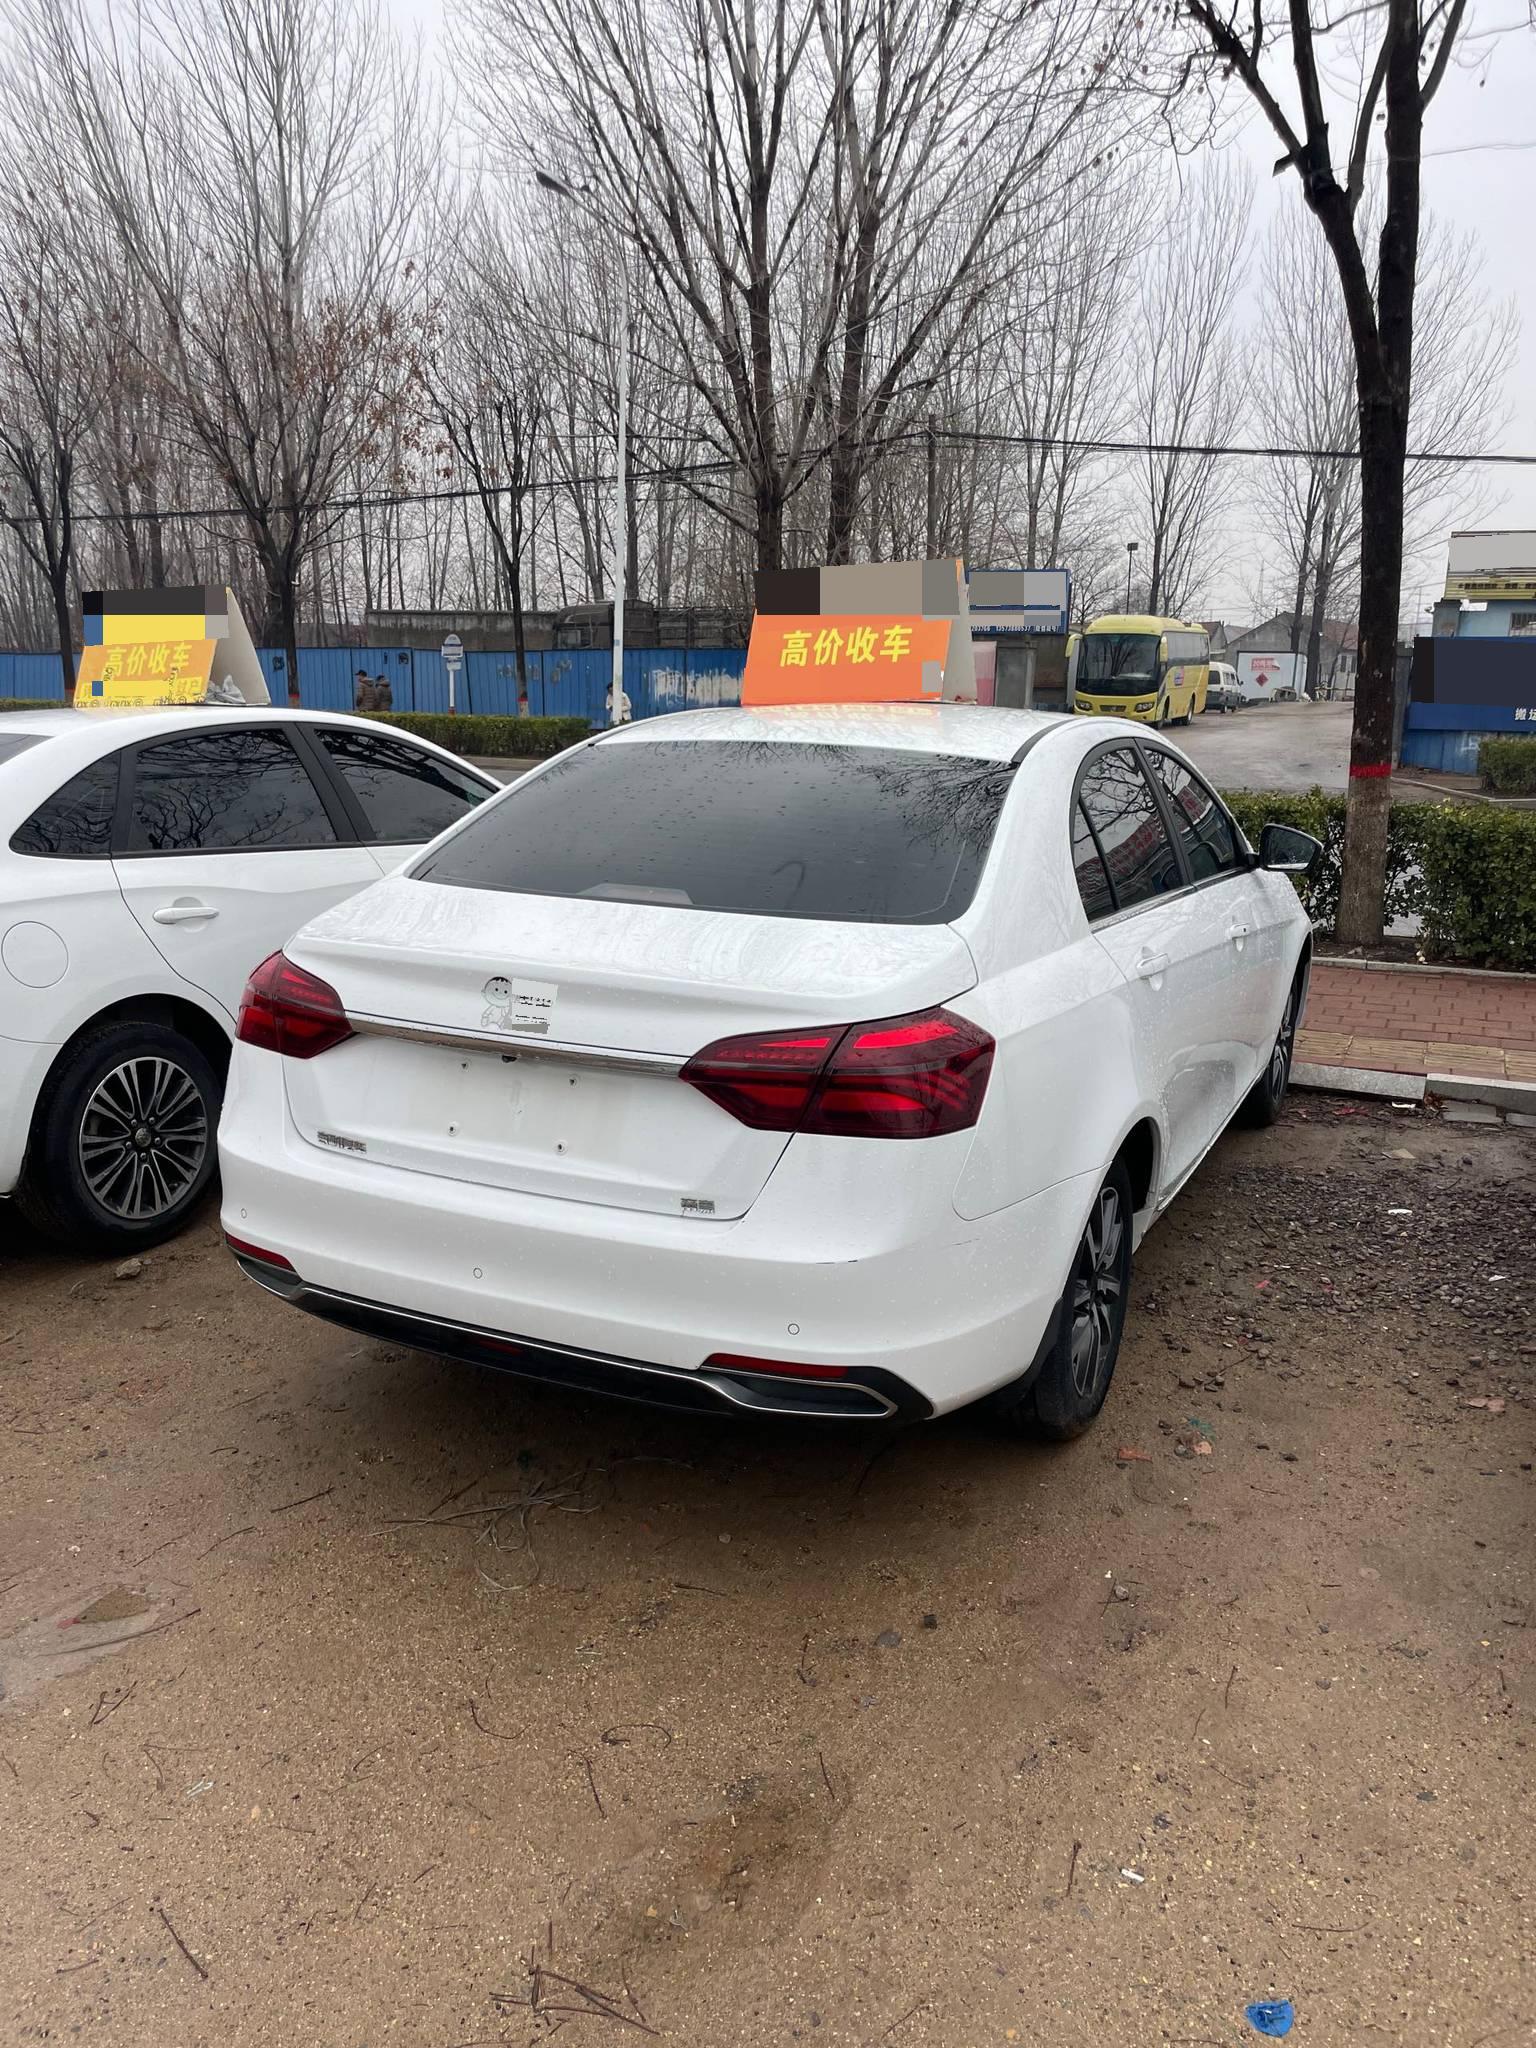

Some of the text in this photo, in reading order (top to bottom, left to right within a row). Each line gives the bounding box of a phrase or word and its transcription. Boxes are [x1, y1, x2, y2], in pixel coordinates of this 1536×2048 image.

[105, 642, 192, 677] 高价收车
[779, 624, 913, 667] 高价收车
